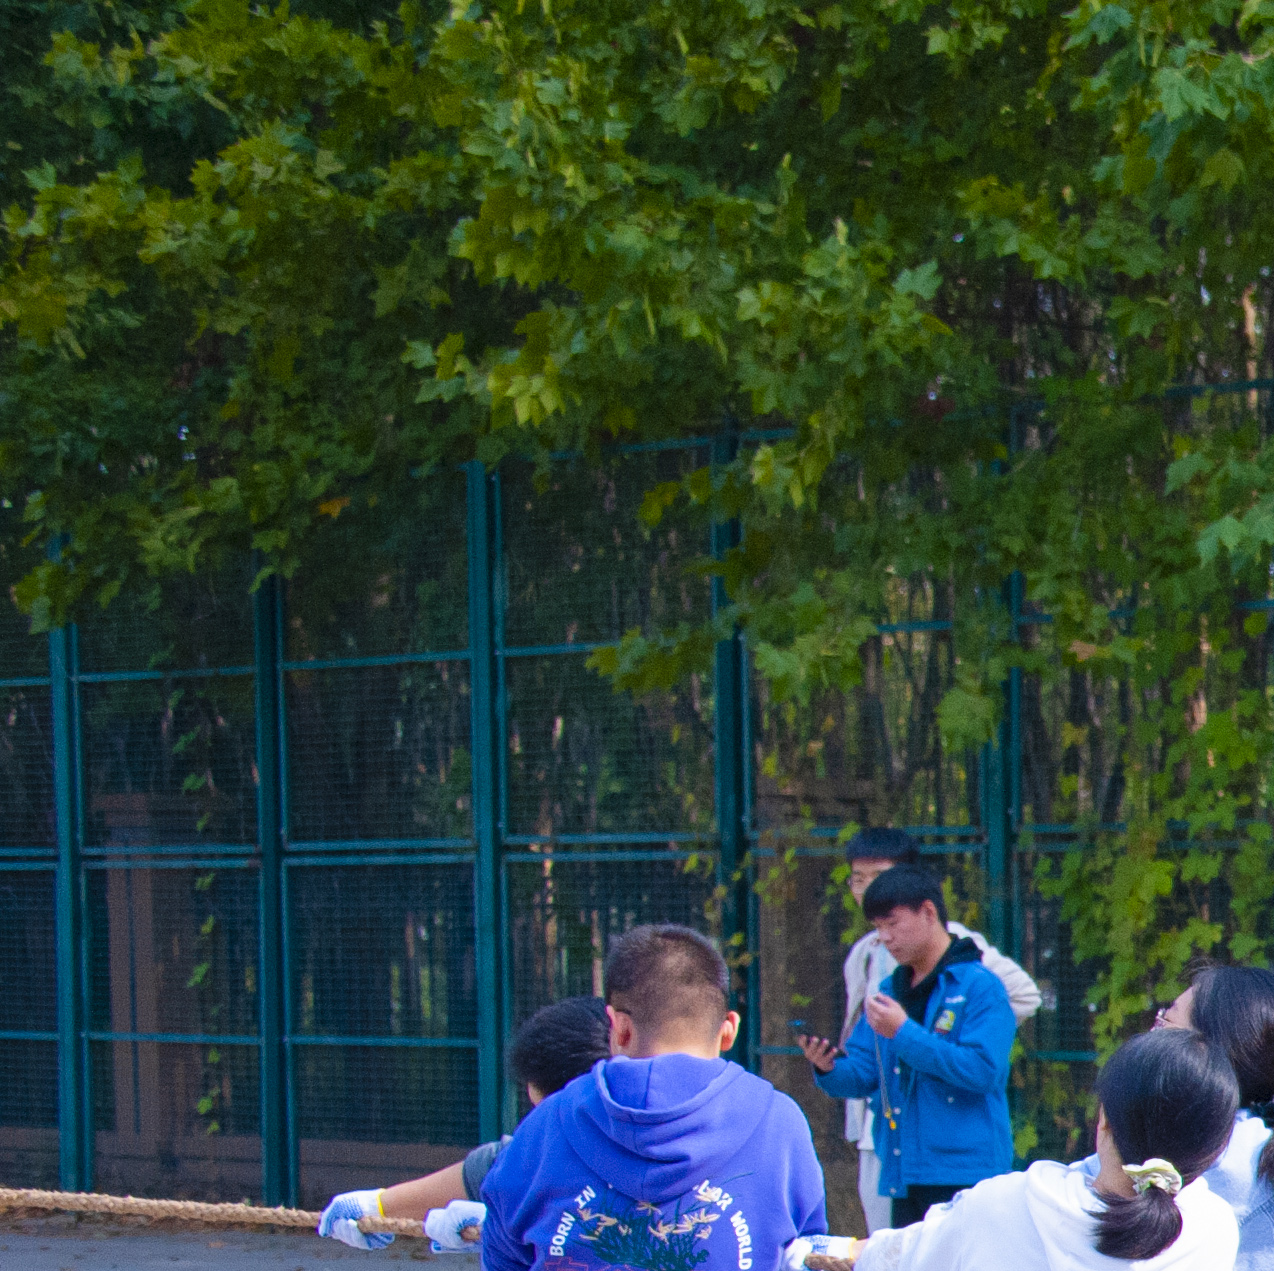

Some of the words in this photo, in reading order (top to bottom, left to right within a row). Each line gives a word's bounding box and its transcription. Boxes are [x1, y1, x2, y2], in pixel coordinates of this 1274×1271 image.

[550, 1211, 576, 1257] BORN
[574, 1185, 596, 1209] IN
[730, 1210, 752, 1270] WORLD
